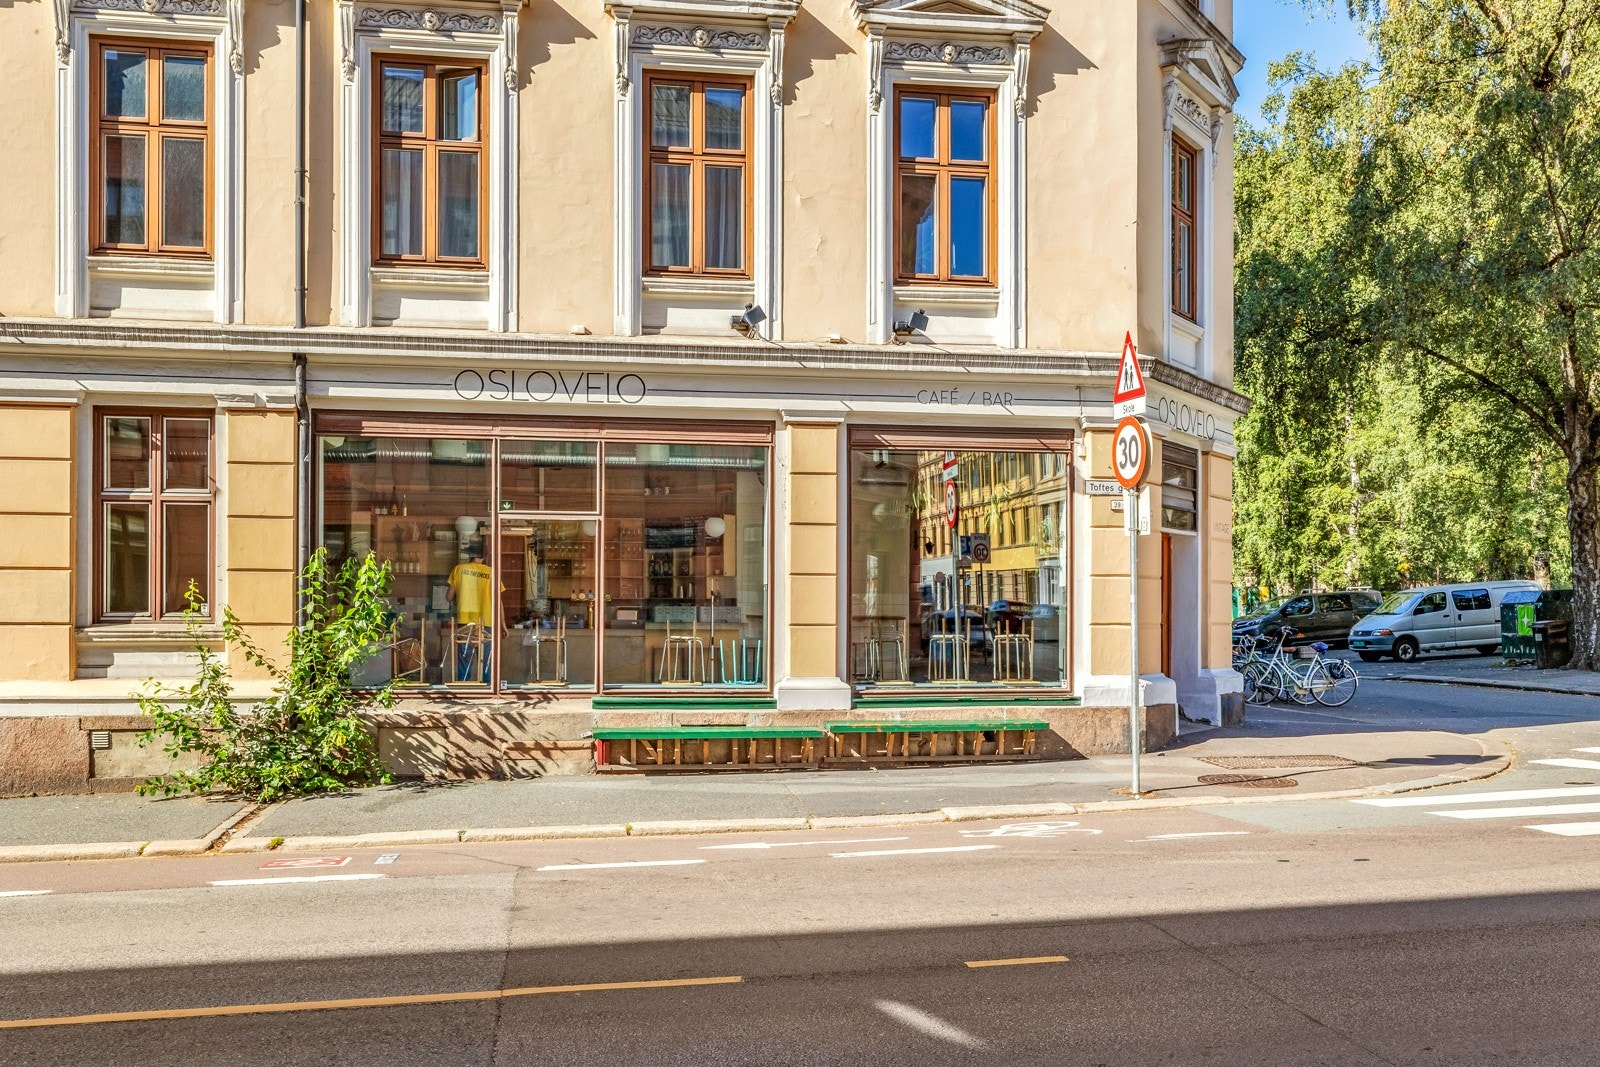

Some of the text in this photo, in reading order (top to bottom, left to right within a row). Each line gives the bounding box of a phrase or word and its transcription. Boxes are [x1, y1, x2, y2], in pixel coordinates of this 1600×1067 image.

[454, 369, 646, 404] OSLOVELO
[917, 387, 959, 405] CAFÉ
[982, 391, 1013, 406] BAR
[1122, 404, 1135, 415] Skole
[1158, 396, 1216, 440] OSLOVELO
[1119, 434, 1139, 470] 30
[1089, 482, 1115, 492] Toftes
